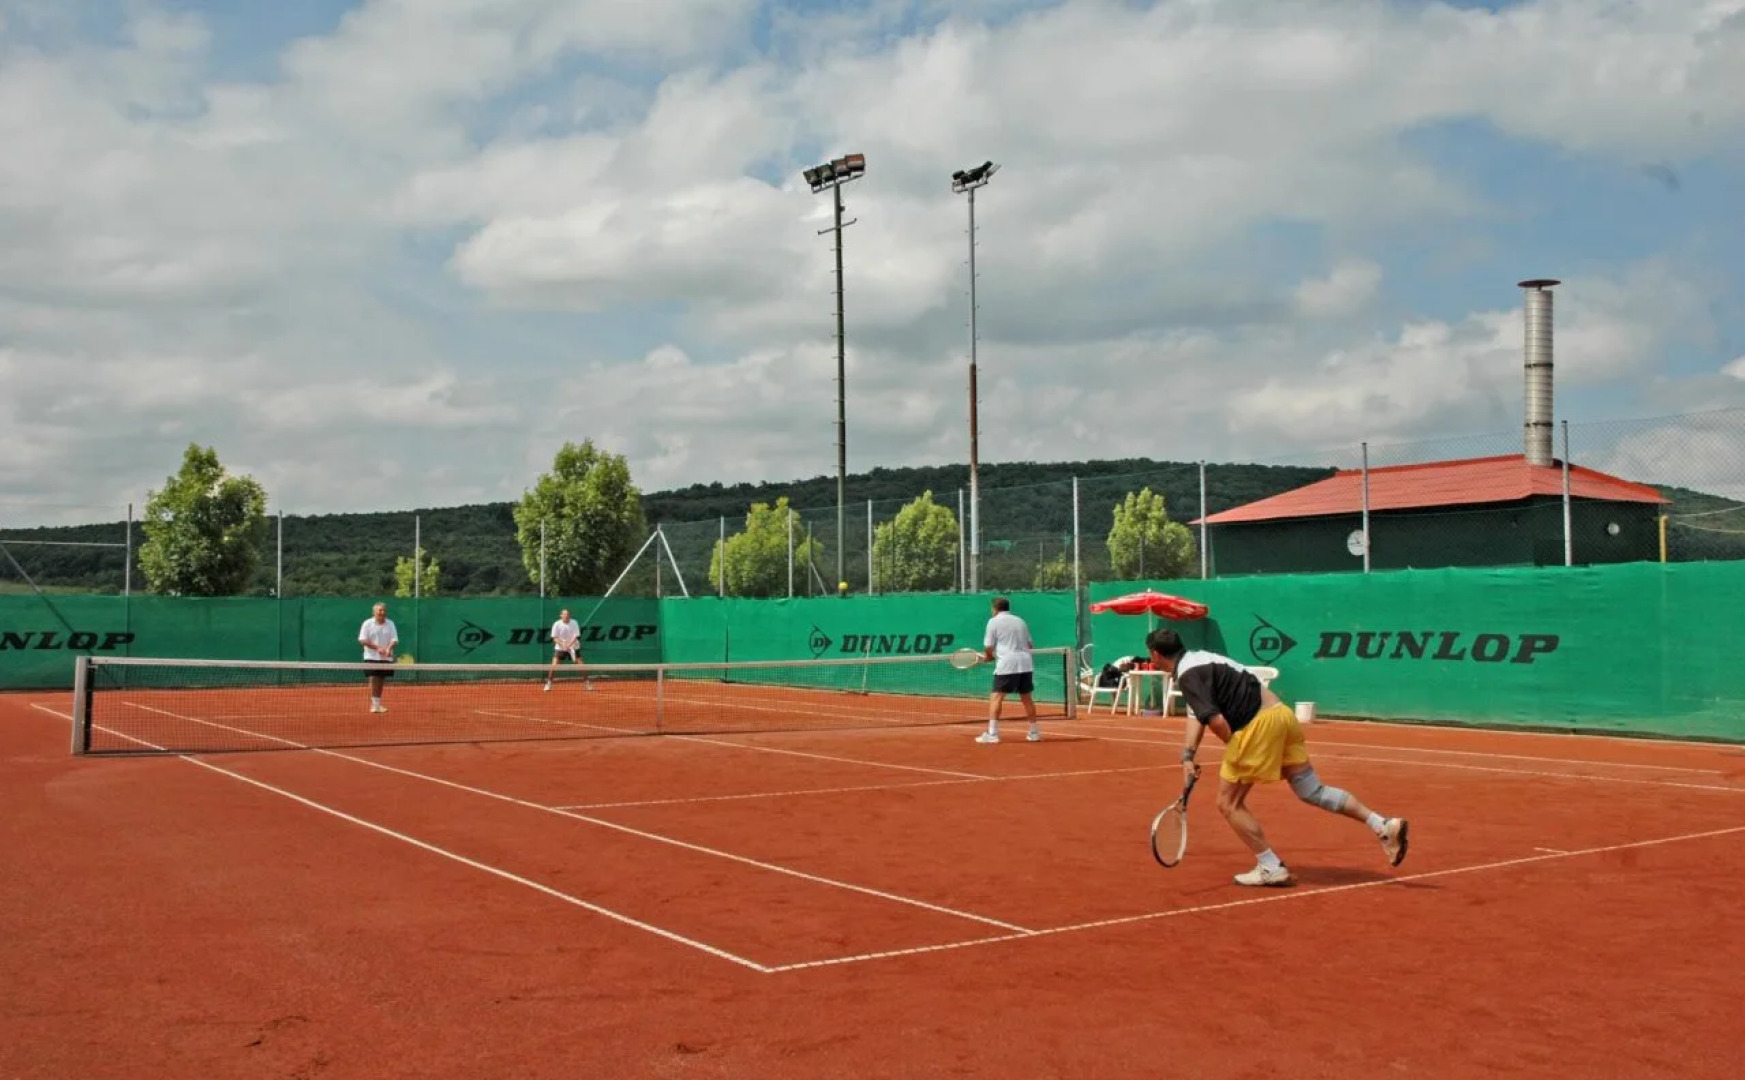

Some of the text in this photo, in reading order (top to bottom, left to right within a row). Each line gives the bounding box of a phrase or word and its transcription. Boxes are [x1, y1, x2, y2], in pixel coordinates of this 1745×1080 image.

[506, 625, 657, 645] DULOP
[840, 634, 955, 653] DUNLOP
[1313, 632, 1560, 664] DUNLOP
